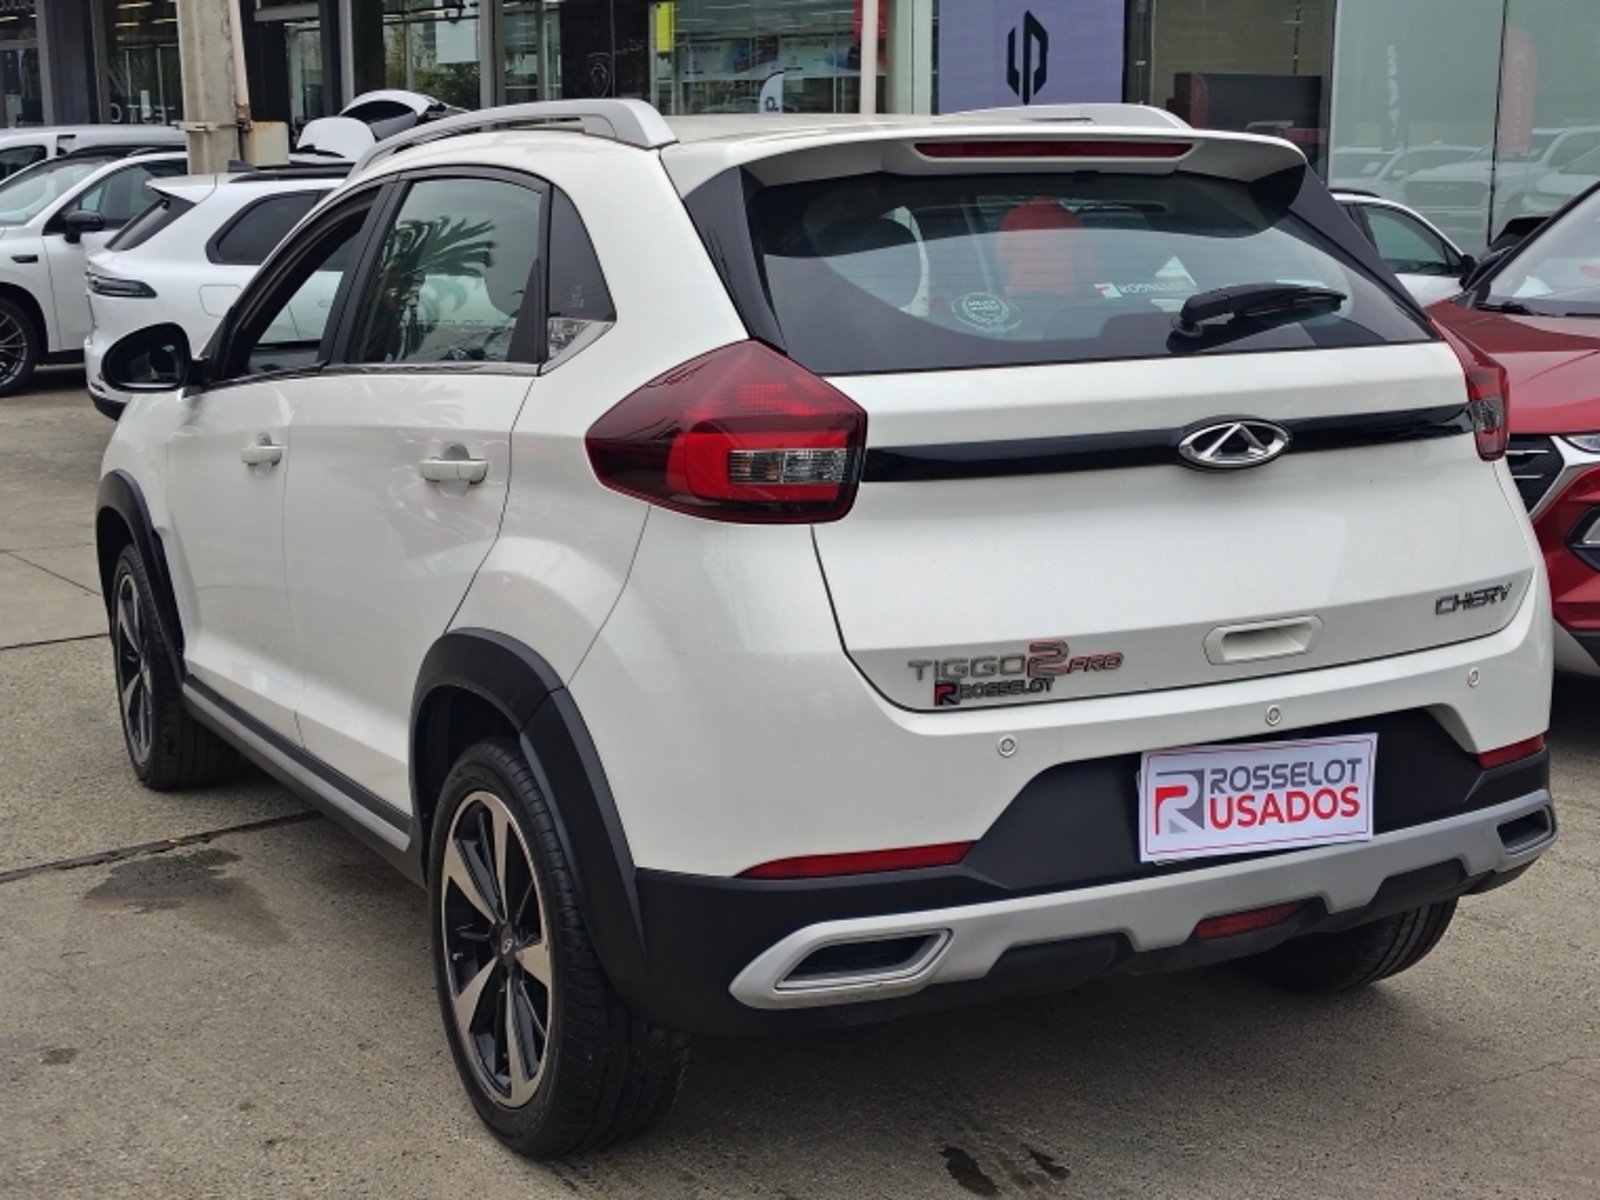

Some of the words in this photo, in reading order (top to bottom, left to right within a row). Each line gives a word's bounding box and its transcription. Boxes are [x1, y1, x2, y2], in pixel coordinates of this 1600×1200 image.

[1435, 582, 1512, 615] CHERY
[907, 653, 1026, 681] TIGGO
[961, 677, 1056, 699] ROSSELOT
[1210, 758, 1362, 795] ROSSELOT
[1209, 786, 1361, 830] USADOS
